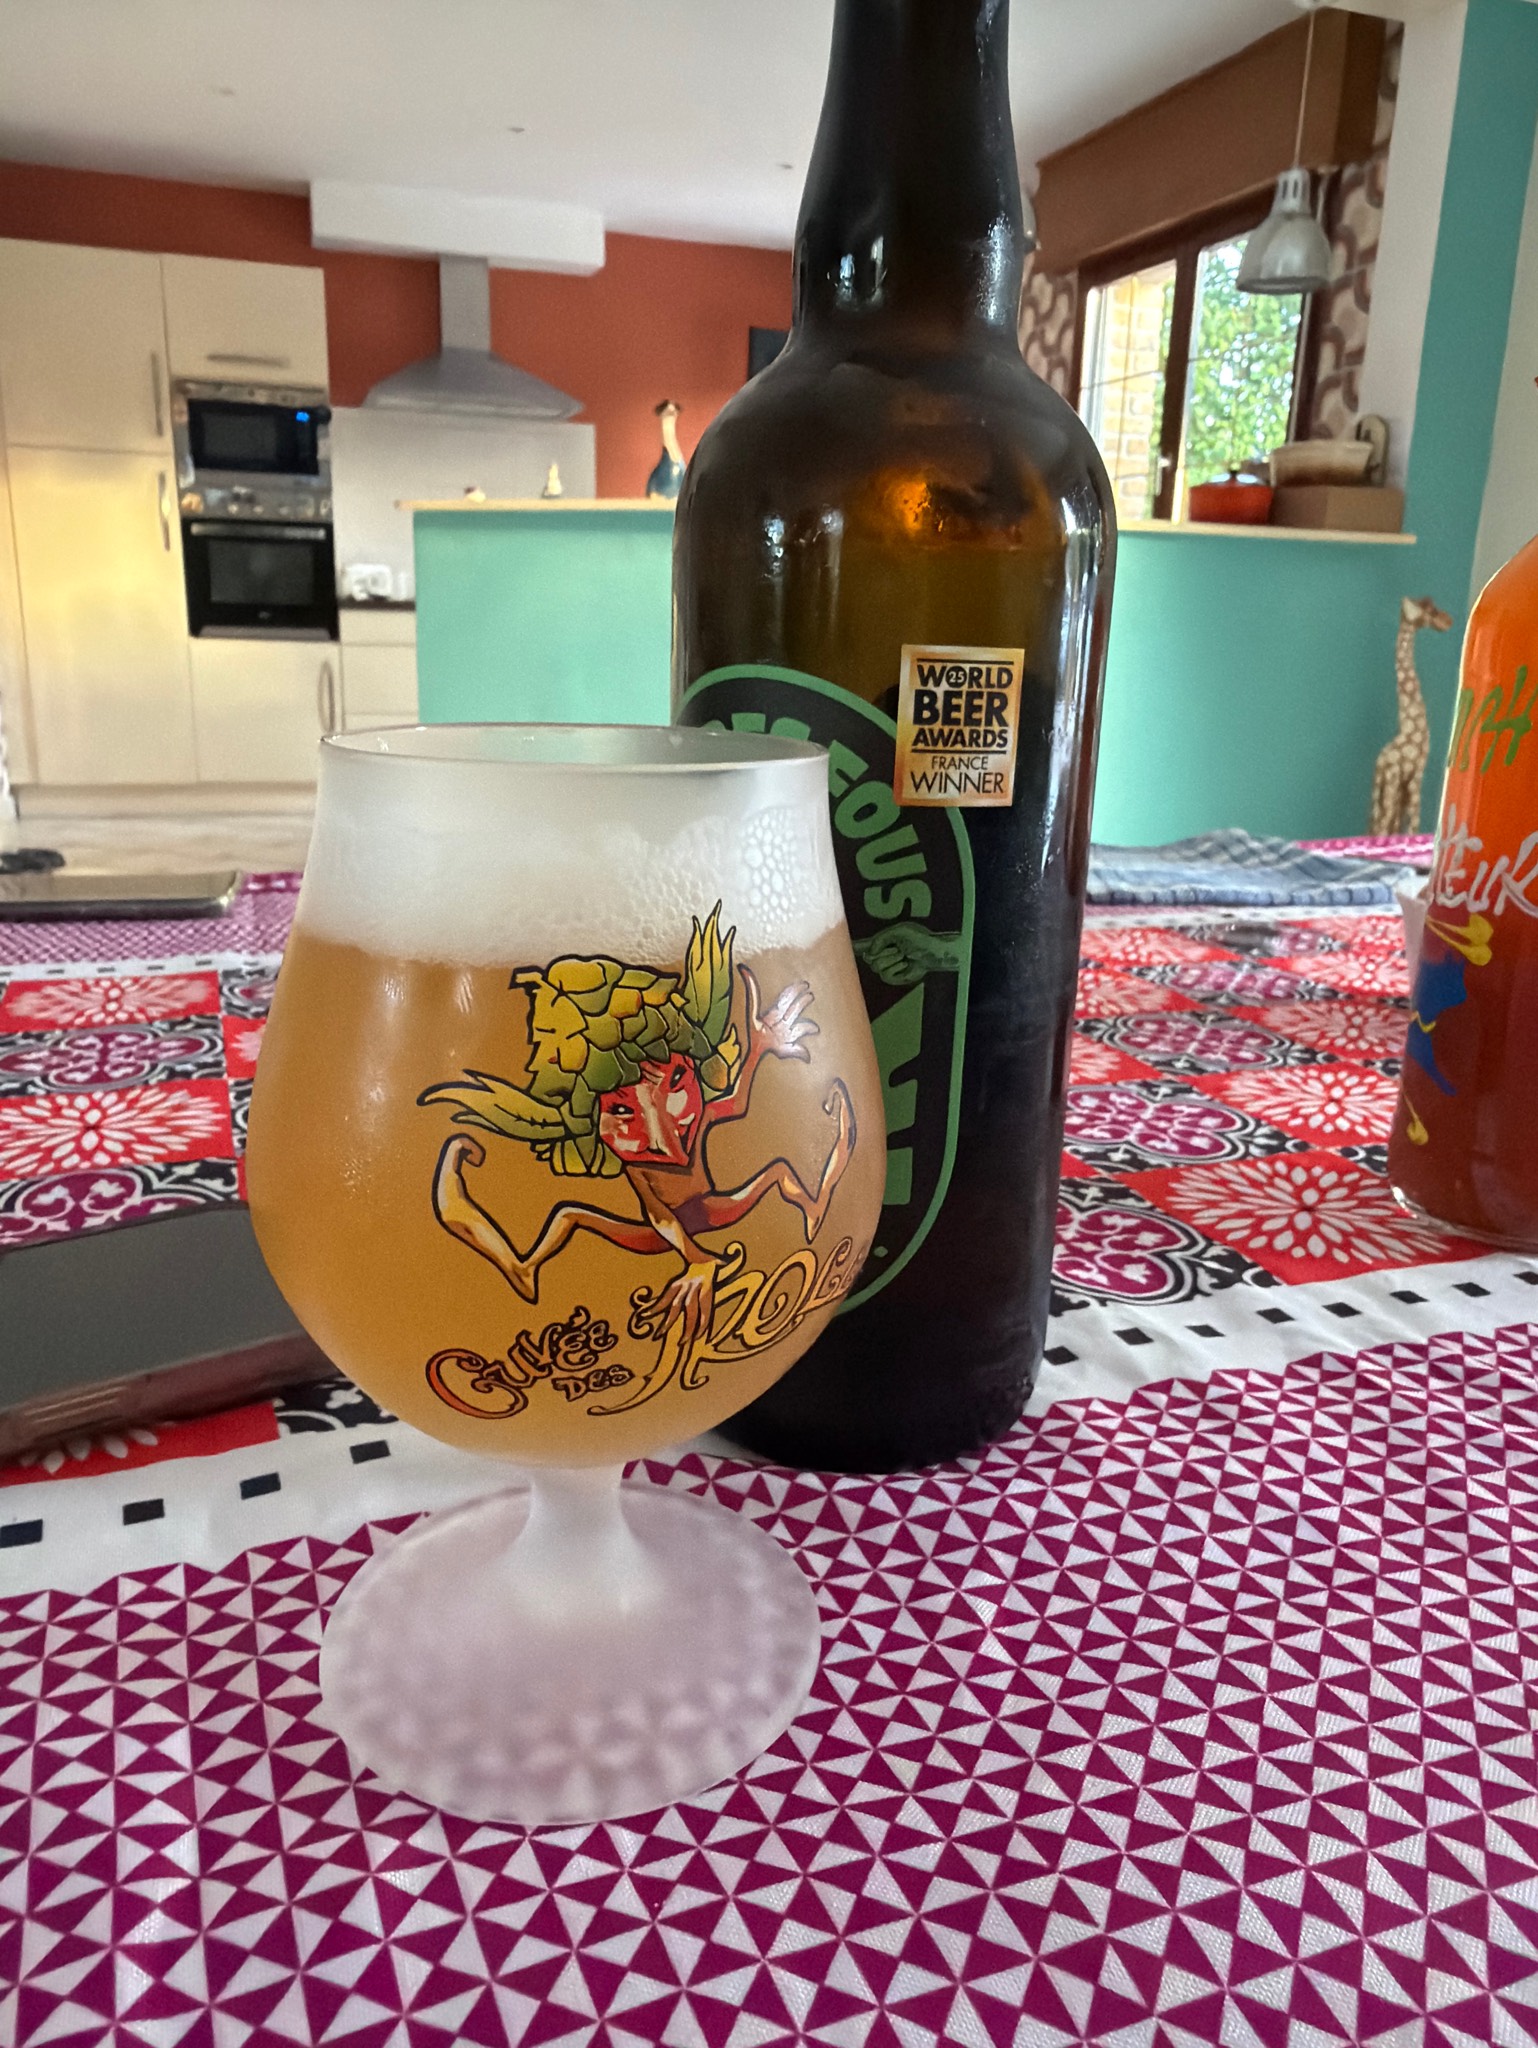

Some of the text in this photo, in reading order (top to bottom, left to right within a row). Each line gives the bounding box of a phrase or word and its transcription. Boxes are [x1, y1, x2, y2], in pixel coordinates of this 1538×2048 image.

[916, 664, 1014, 689] WORLD
[948, 670, 965, 684] 25
[912, 688, 1009, 728] BEER
[911, 727, 1009, 749] AWARDS
[931, 755, 989, 771] FRANCE
[910, 771, 1005, 794] WINNER
